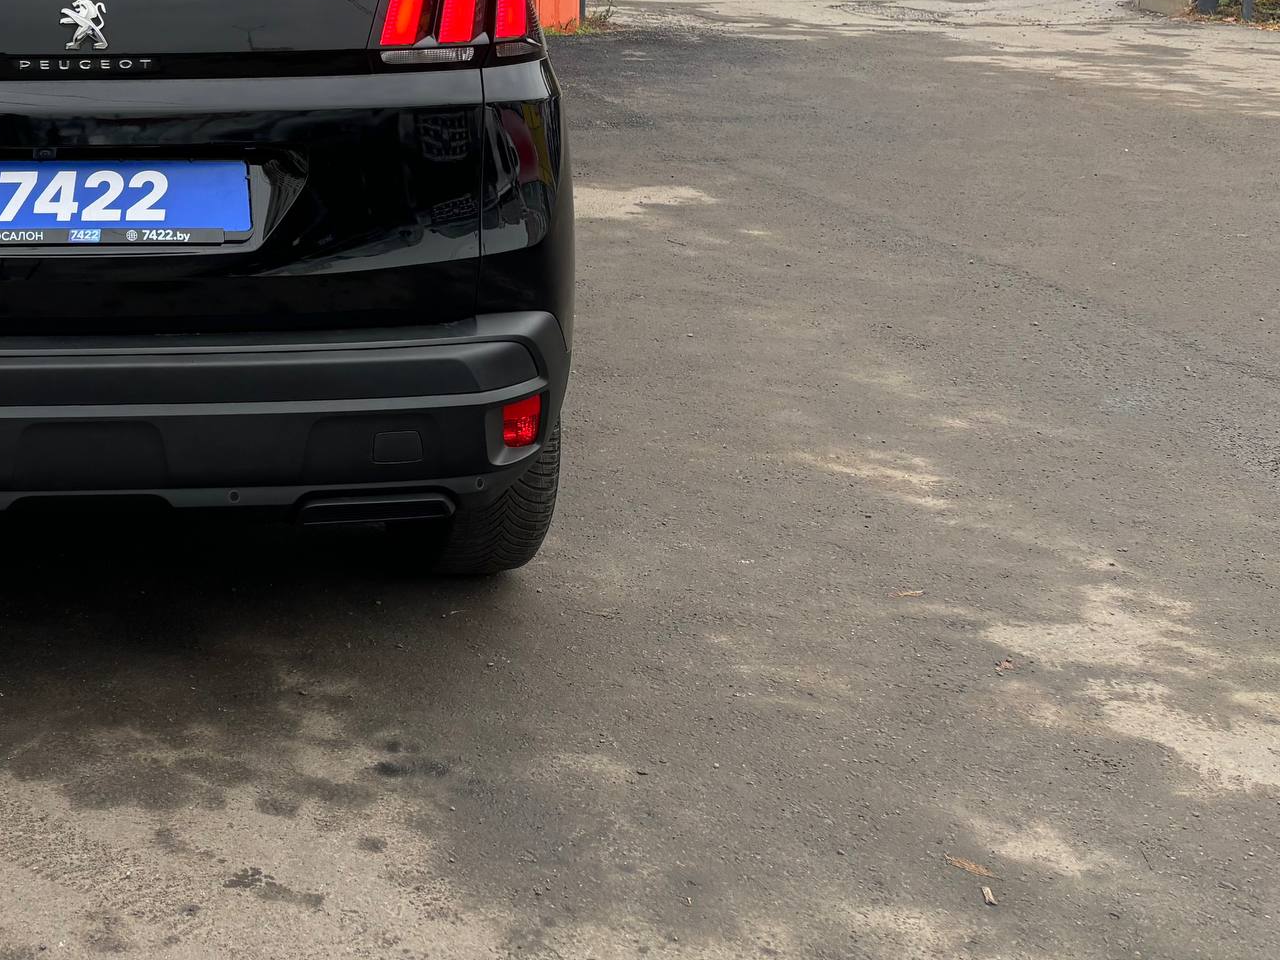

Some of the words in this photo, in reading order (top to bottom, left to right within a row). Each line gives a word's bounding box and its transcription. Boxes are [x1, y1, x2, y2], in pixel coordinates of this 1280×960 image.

[19, 59, 152, 70] PEUGEOT
[70, 230, 99, 240] 7422
[142, 230, 191, 242] 7422.by
